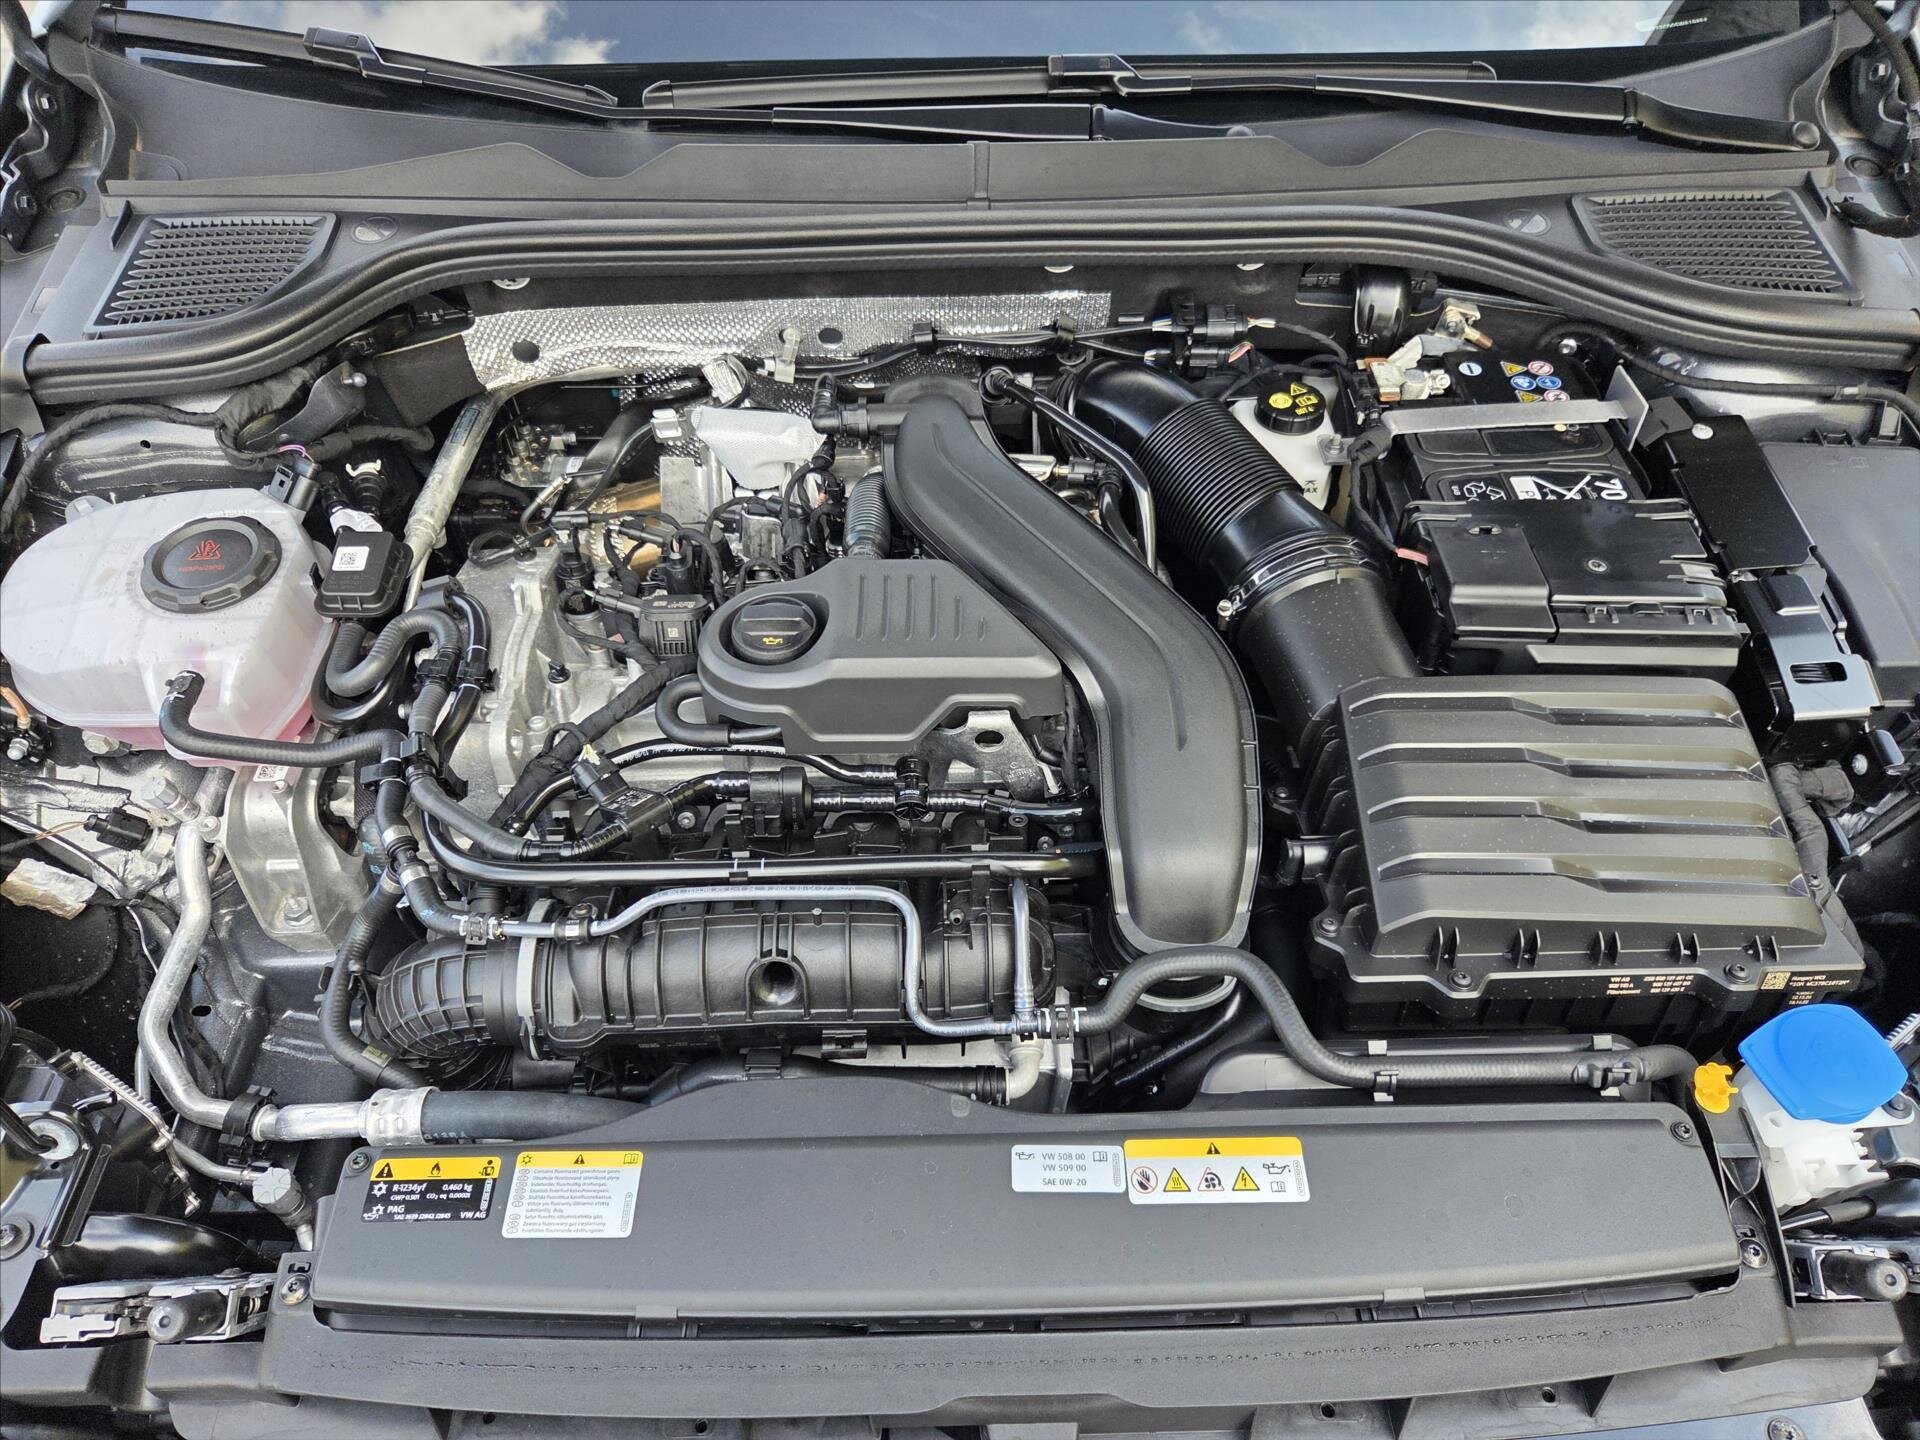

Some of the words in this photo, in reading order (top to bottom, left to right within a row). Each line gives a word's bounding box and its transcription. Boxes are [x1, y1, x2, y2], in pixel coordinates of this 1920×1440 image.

[1594, 477, 1628, 500] 70
[1042, 1164, 1056, 1172] VW
[1058, 1164, 1073, 1172] 509
[1075, 1164, 1087, 1172] 00
[1042, 1178, 1056, 1186] SAE
[1059, 1178, 1087, 1186] 0W-20
[392, 1183, 428, 1193] R-1234yf
[387, 1205, 405, 1213] PAG
[460, 1211, 474, 1219] VW
[474, 1211, 487, 1219] AG
